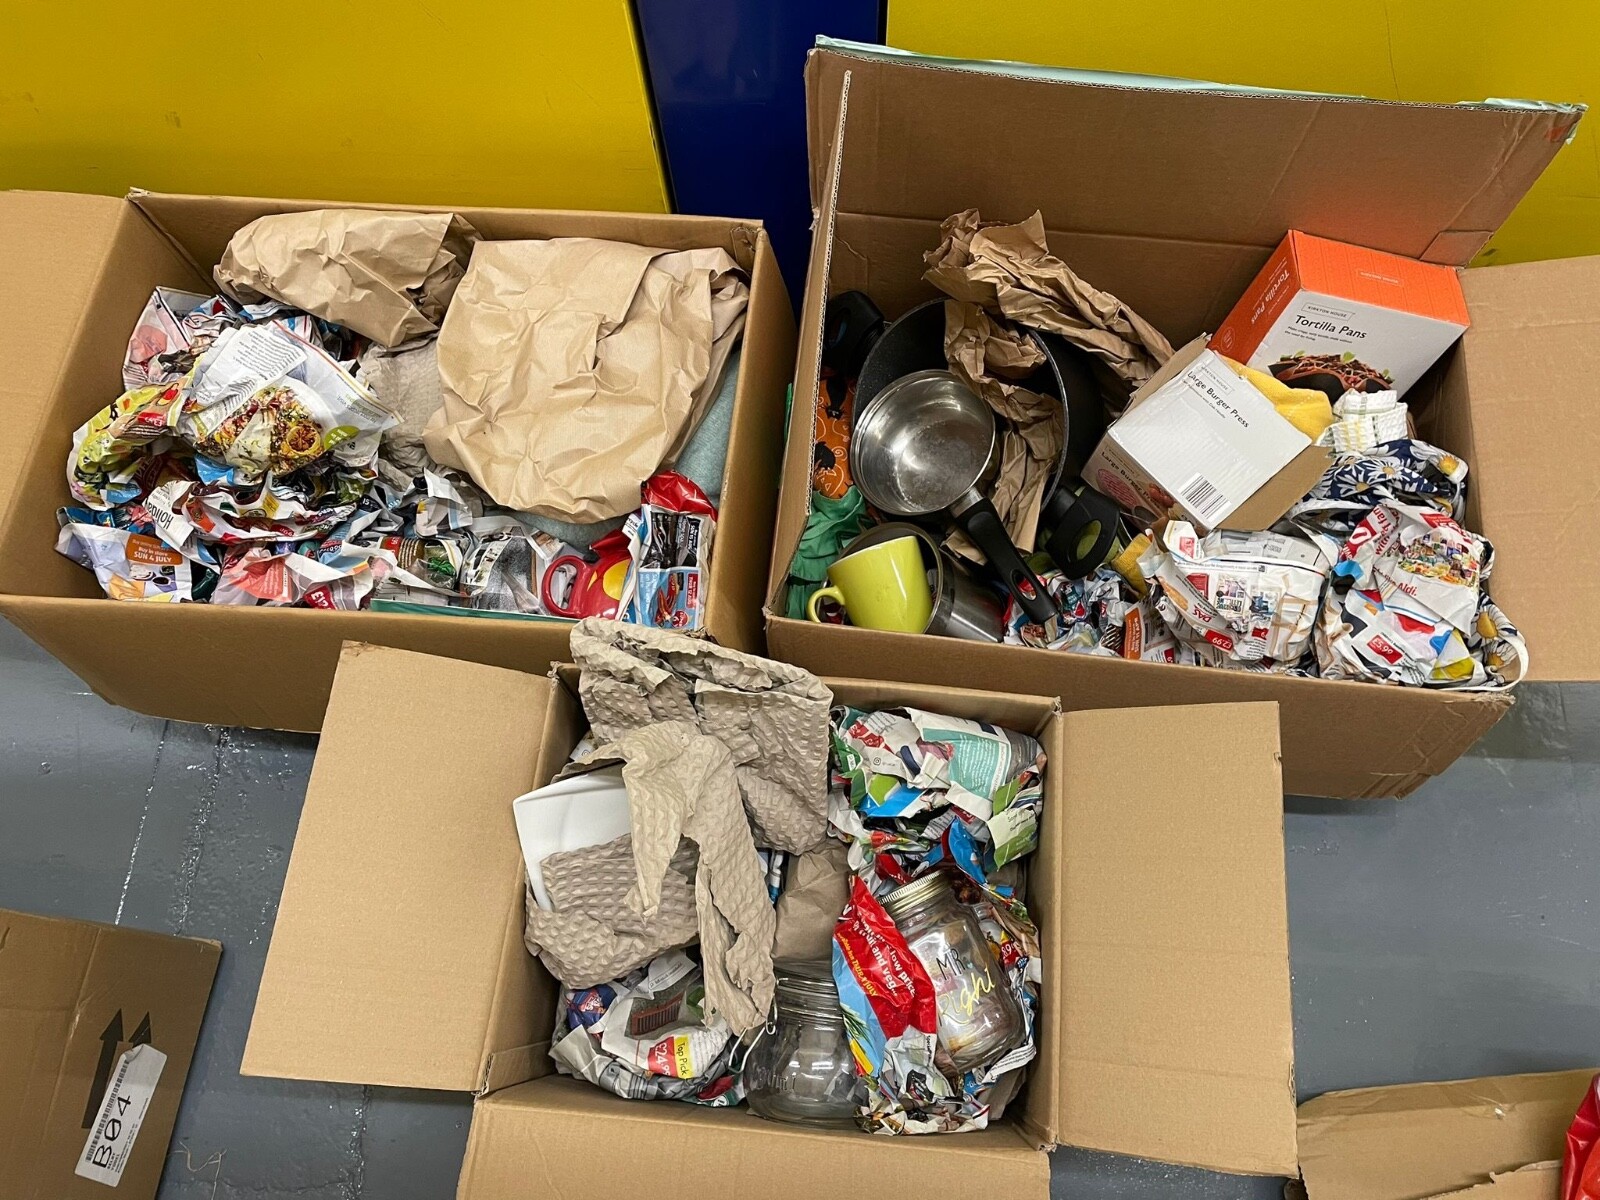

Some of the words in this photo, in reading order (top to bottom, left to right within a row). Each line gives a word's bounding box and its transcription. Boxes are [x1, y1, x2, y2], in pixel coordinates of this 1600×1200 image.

[1265, 270, 1290, 302] Tortilla
[1251, 301, 1266, 325] Pans
[1330, 310, 1348, 318] HOUSE
[1295, 314, 1336, 333] Tortilla
[1338, 325, 1367, 339] Pans
[1187, 370, 1207, 389] Large
[1206, 387, 1231, 410] Burger
[1230, 408, 1250, 428] Press
[1101, 451, 1120, 470] Large
[1120, 469, 1143, 491] Burger
[134, 551, 148, 559] SUN
[1193, 604, 1212, 623] DAS
[1212, 636, 1233, 649] £2.99
[1371, 635, 1395, 656] £5.99
[871, 946, 887, 967] and
[889, 949, 903, 971] low
[936, 948, 966, 981] MR
[863, 980, 878, 997] JULY
[676, 1041, 685, 1058] Top
[679, 1057, 689, 1076] Pick
[92, 1095, 131, 1168] B04
